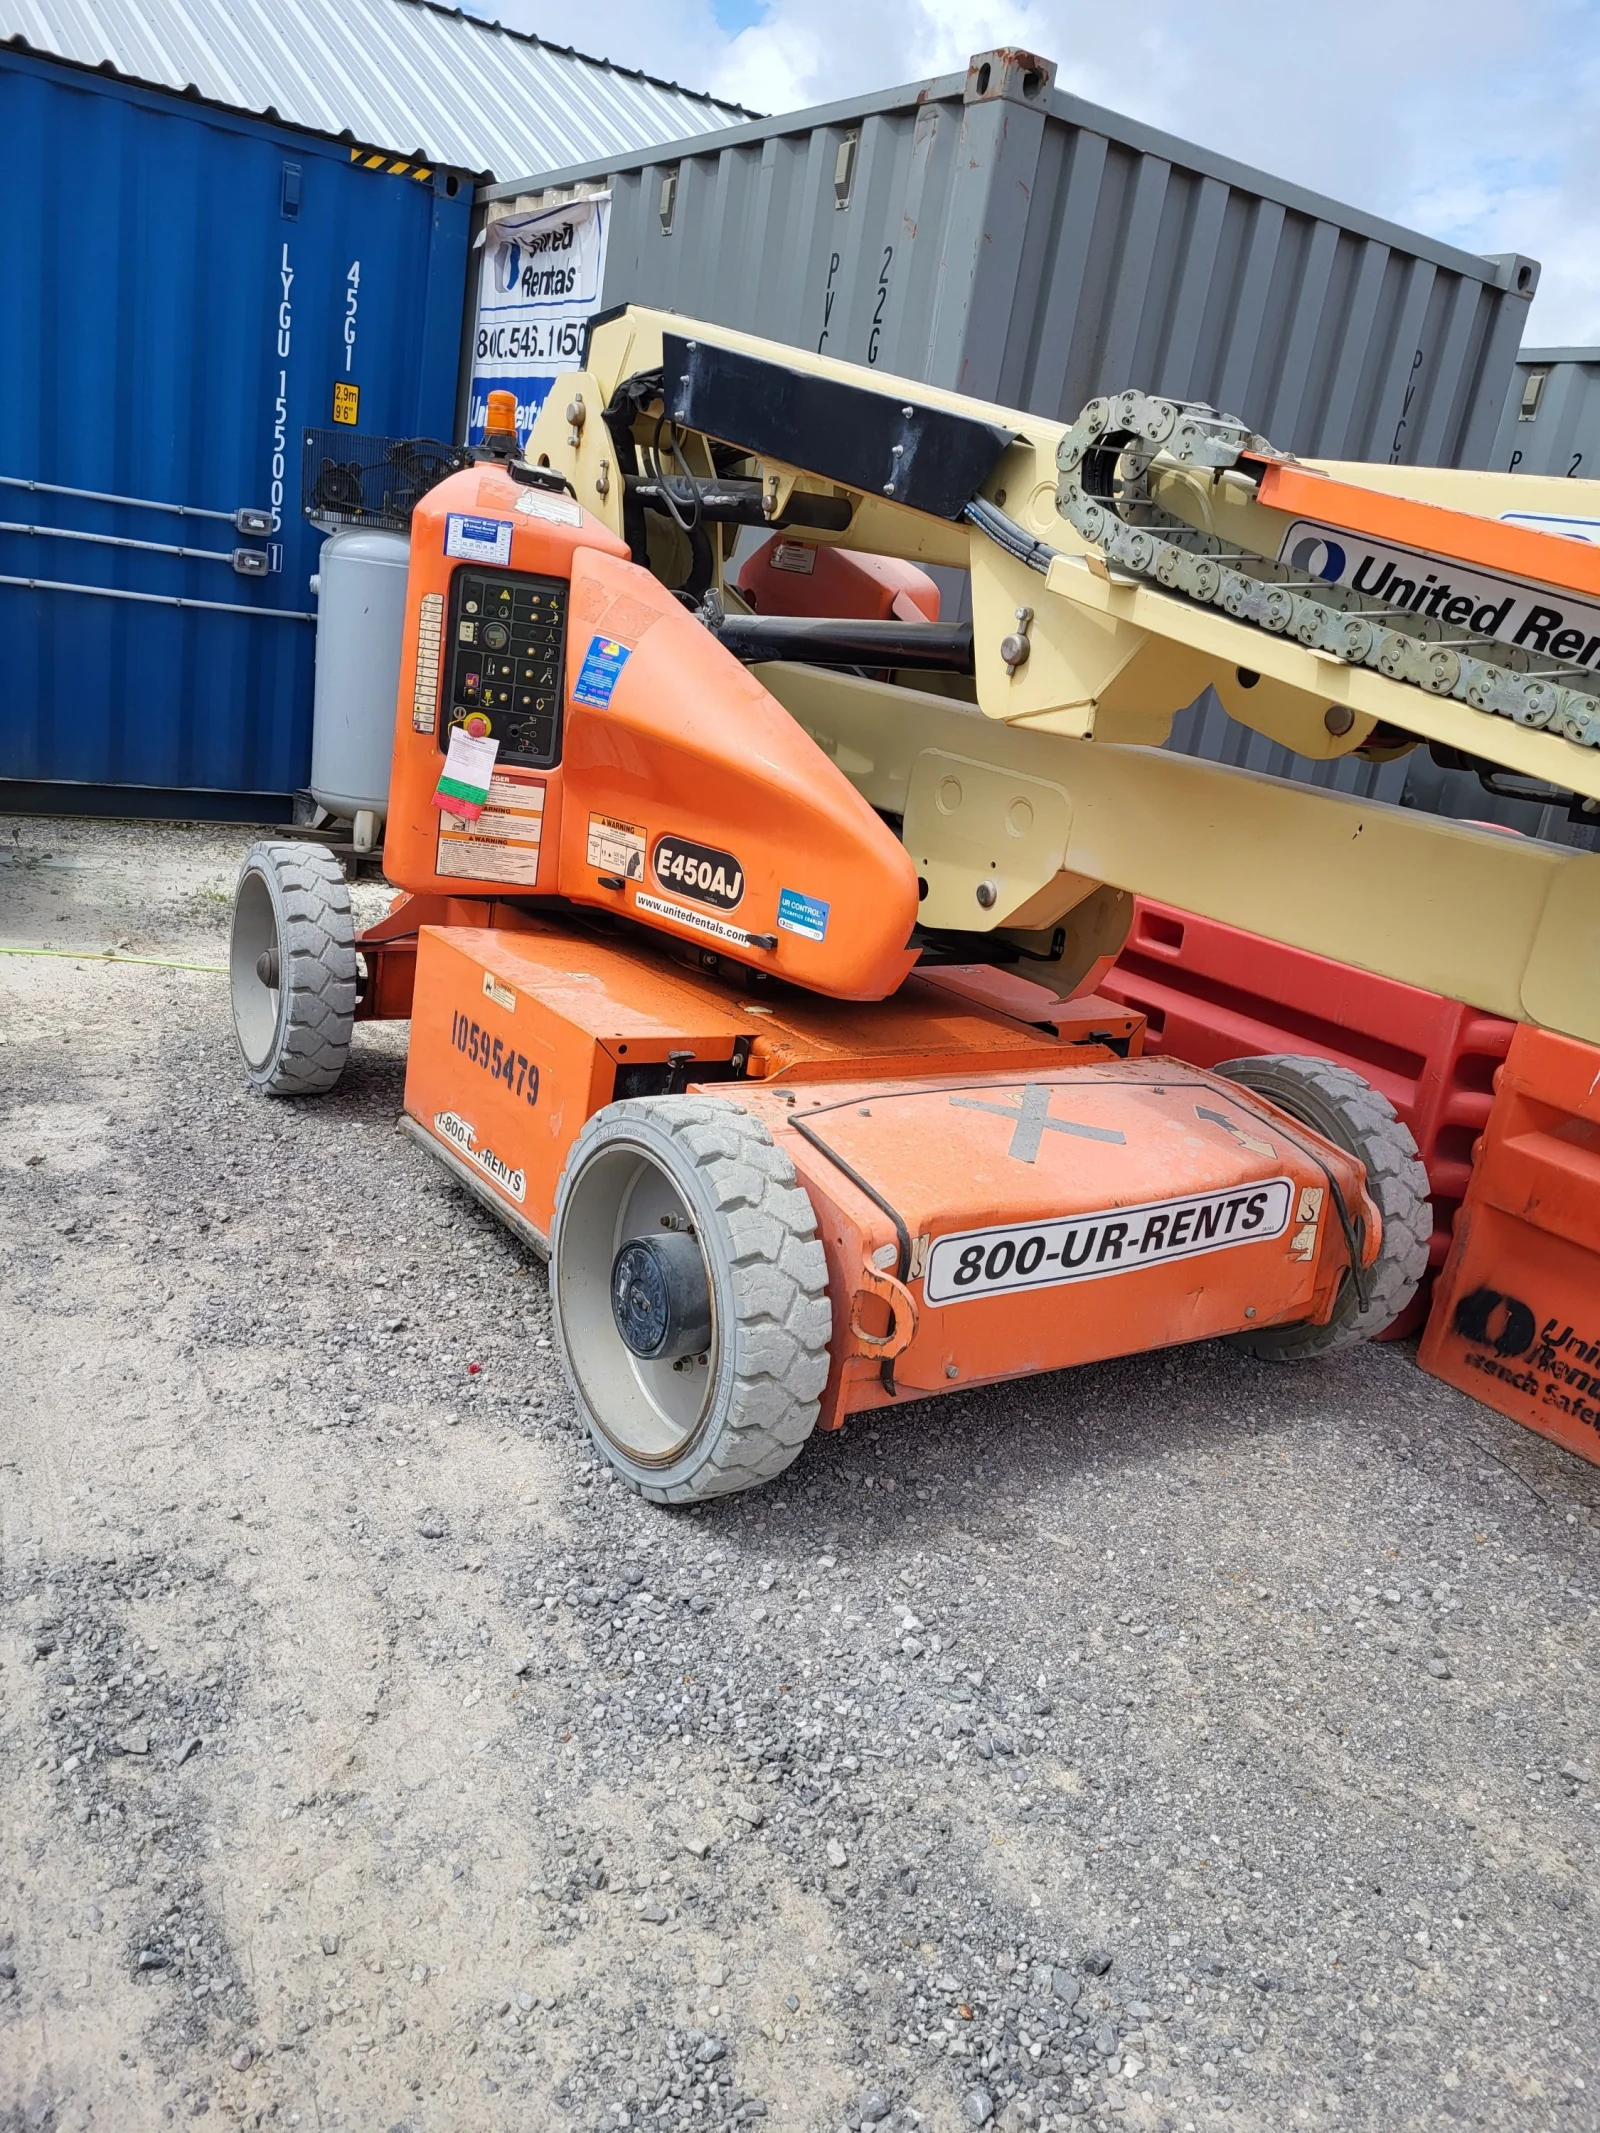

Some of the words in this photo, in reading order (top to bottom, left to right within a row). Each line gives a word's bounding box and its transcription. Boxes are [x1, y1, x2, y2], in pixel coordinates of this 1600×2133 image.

[277, 243, 295, 358] LYGU
[344, 260, 361, 372] 45G1
[818, 252, 840, 355] PVC
[868, 246, 893, 369] 22G
[335, 386, 357, 404] 2,9m
[1388, 349, 1423, 465] PVC
[271, 370, 287, 533] 155005
[1351, 555, 1517, 637] United
[483, 806, 511, 815] ARNING
[491, 774, 510, 783] NGER
[474, 836, 508, 846] WARNING
[606, 818, 635, 835] WARNING
[656, 847, 743, 900] E450AJ
[781, 897, 791, 908] UR
[790, 901, 821, 918] CONTROL
[637, 895, 750, 944] www.unitedrentals.com
[451, 1009, 540, 1107] 10595479
[952, 1191, 1268, 1287] 800-UR-RENTS
